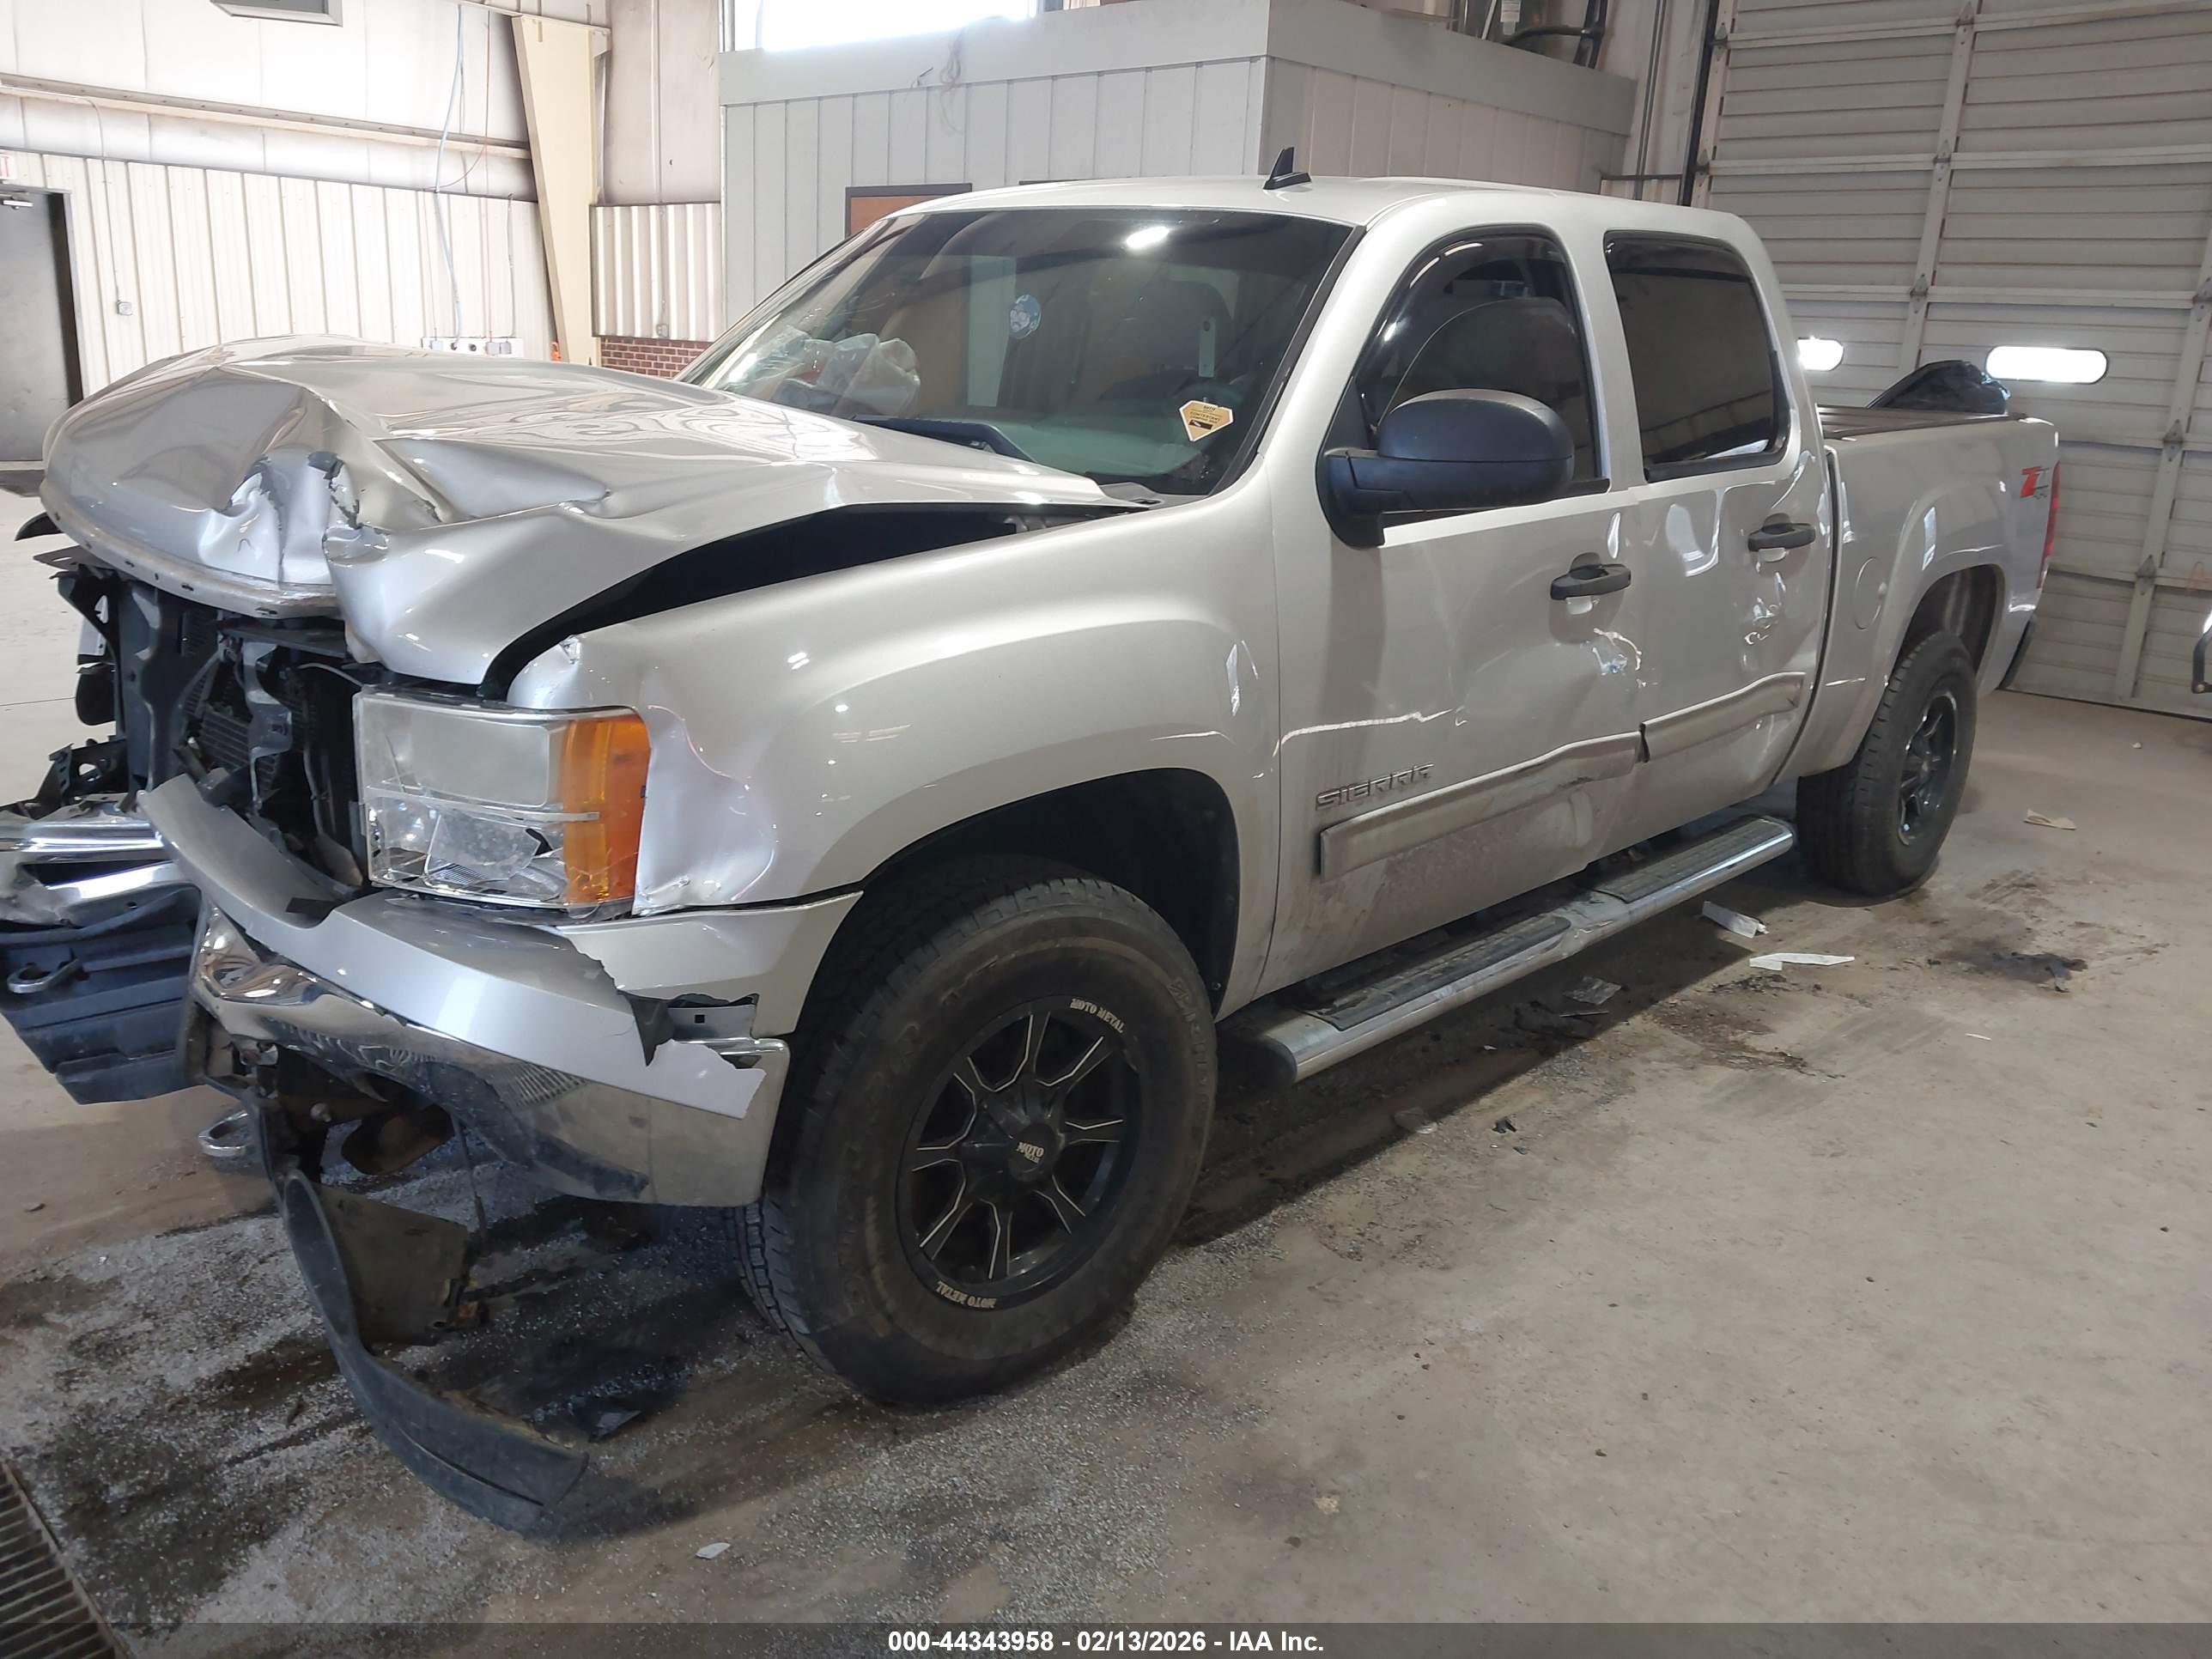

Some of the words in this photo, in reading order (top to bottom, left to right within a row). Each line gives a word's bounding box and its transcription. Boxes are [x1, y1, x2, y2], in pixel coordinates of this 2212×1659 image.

[1316, 763, 1435, 811] SIERRA
[1070, 998, 1097, 1014] MOTO
[1097, 1006, 1125, 1033] METAL
[1016, 1141, 1044, 1158] MOTO
[935, 1280, 966, 1305] METAL
[966, 1295, 997, 1309] MOTO
